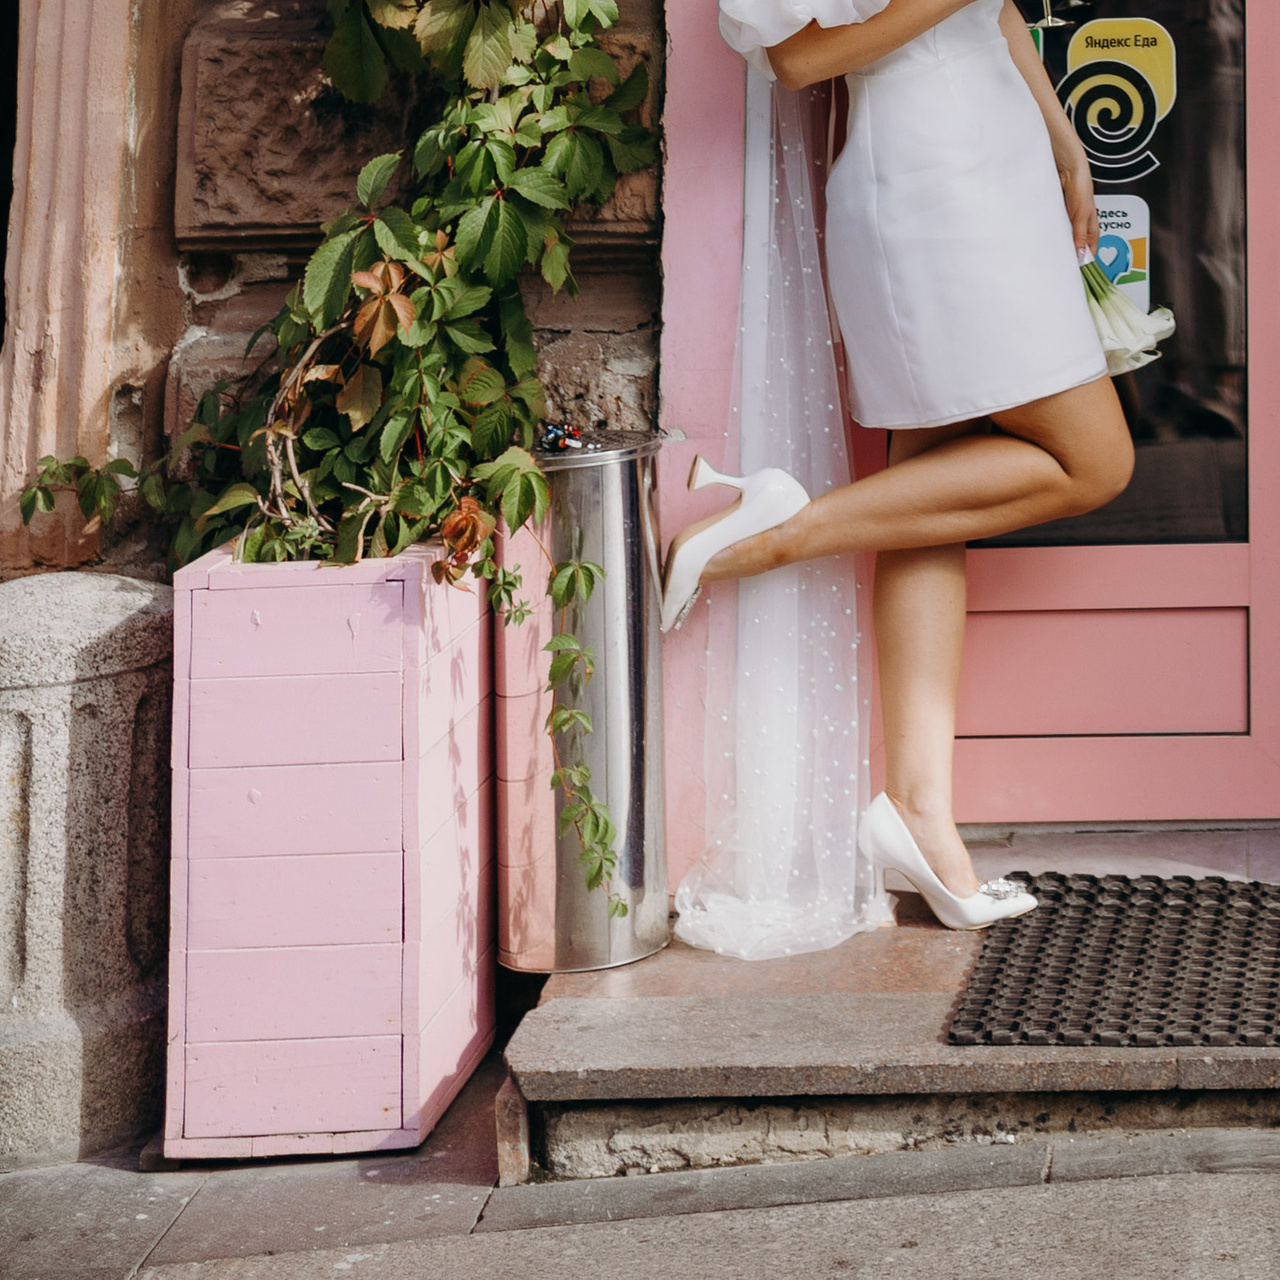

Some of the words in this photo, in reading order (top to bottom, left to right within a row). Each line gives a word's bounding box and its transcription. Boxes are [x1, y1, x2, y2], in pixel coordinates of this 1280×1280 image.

[1085, 35, 1131, 49] Яндекс
[1134, 34, 1158, 48] Еда
[1099, 221, 1131, 232] усно
